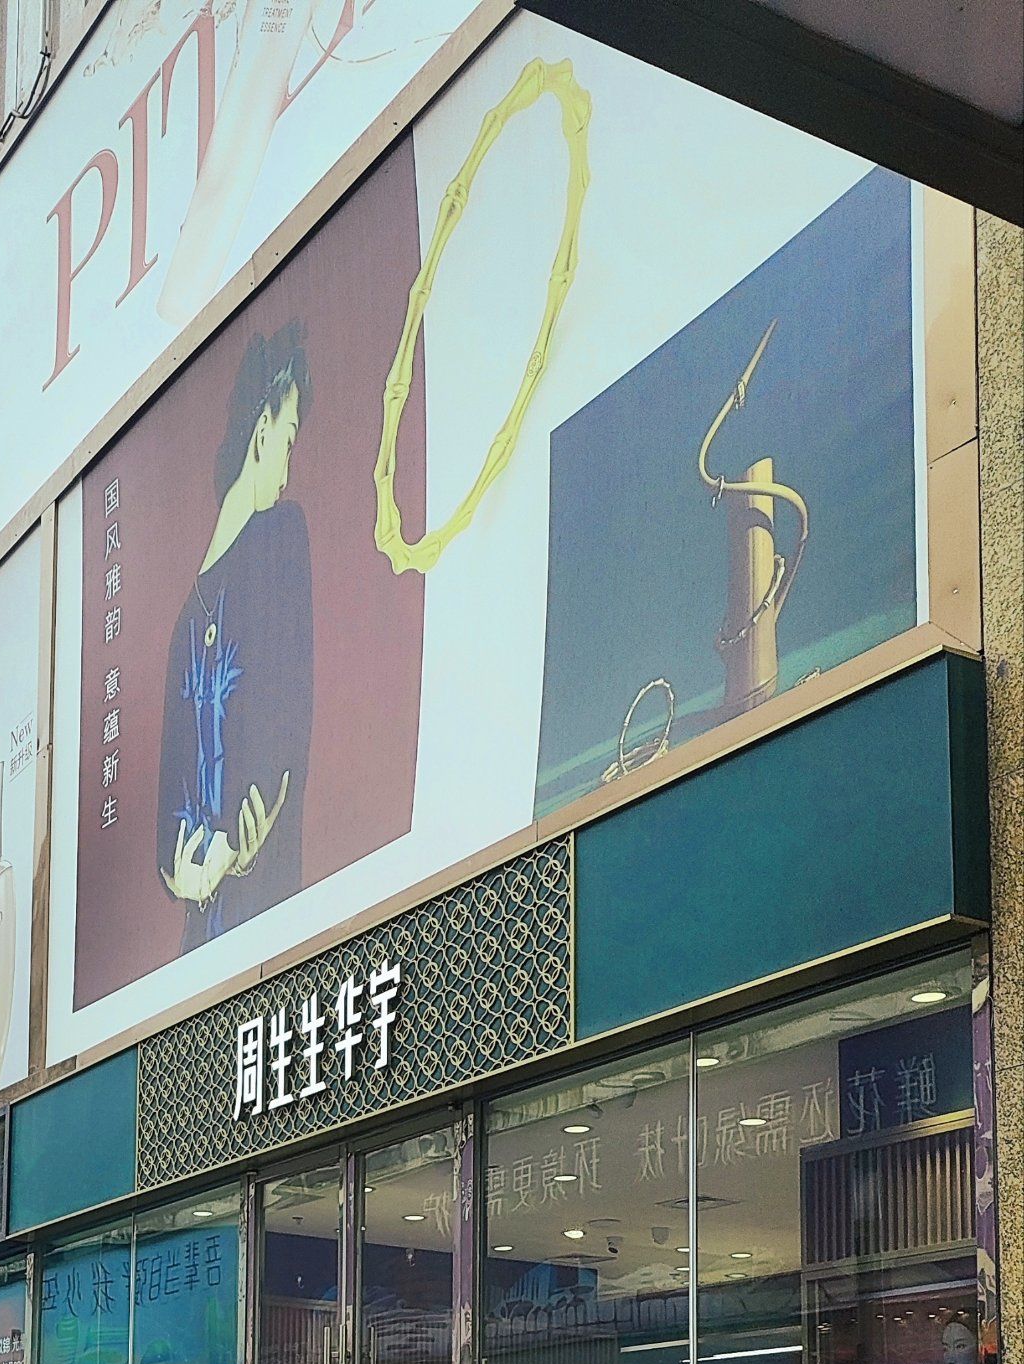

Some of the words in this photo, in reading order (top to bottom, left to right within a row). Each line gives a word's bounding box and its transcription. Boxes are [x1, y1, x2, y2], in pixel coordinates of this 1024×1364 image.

[260, 21, 287, 33] ESSENCE
[103, 478, 121, 644] 国风雅韵
[9, 718, 34, 752] New
[9, 742, 34, 776] 新升级
[100, 668, 121, 829] 意蕴新生
[232, 960, 402, 1121] 周生生华宇
